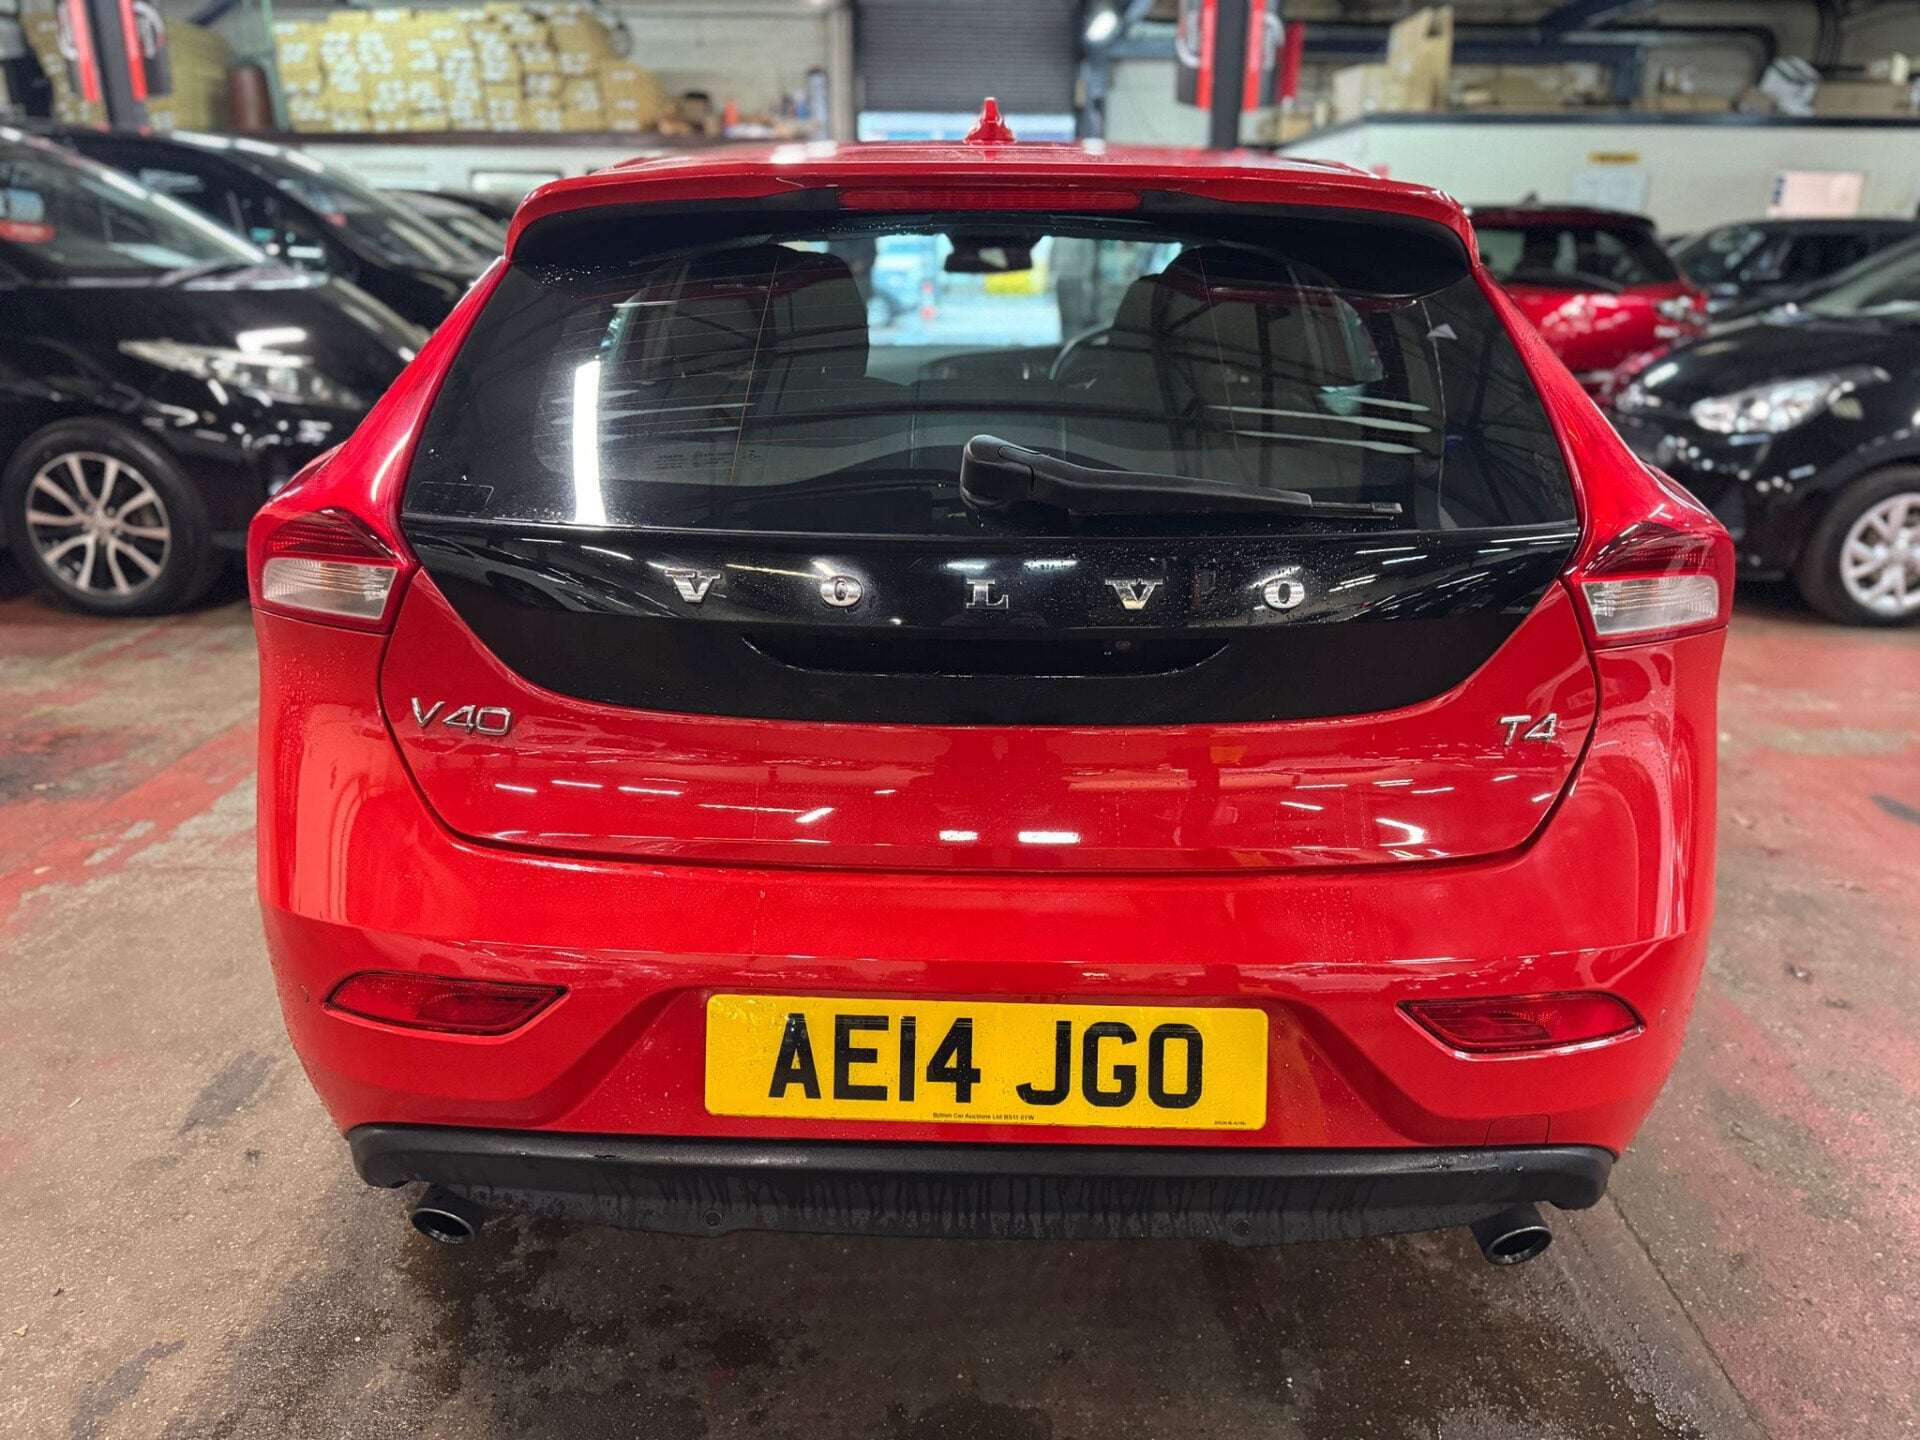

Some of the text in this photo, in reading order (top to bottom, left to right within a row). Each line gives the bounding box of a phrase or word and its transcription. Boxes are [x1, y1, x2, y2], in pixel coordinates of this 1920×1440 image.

[663, 568, 1305, 611] VOLVO
[410, 696, 513, 737] V40
[1498, 712, 1558, 746] T4
[768, 1012, 1204, 1110] AE14 JGO
